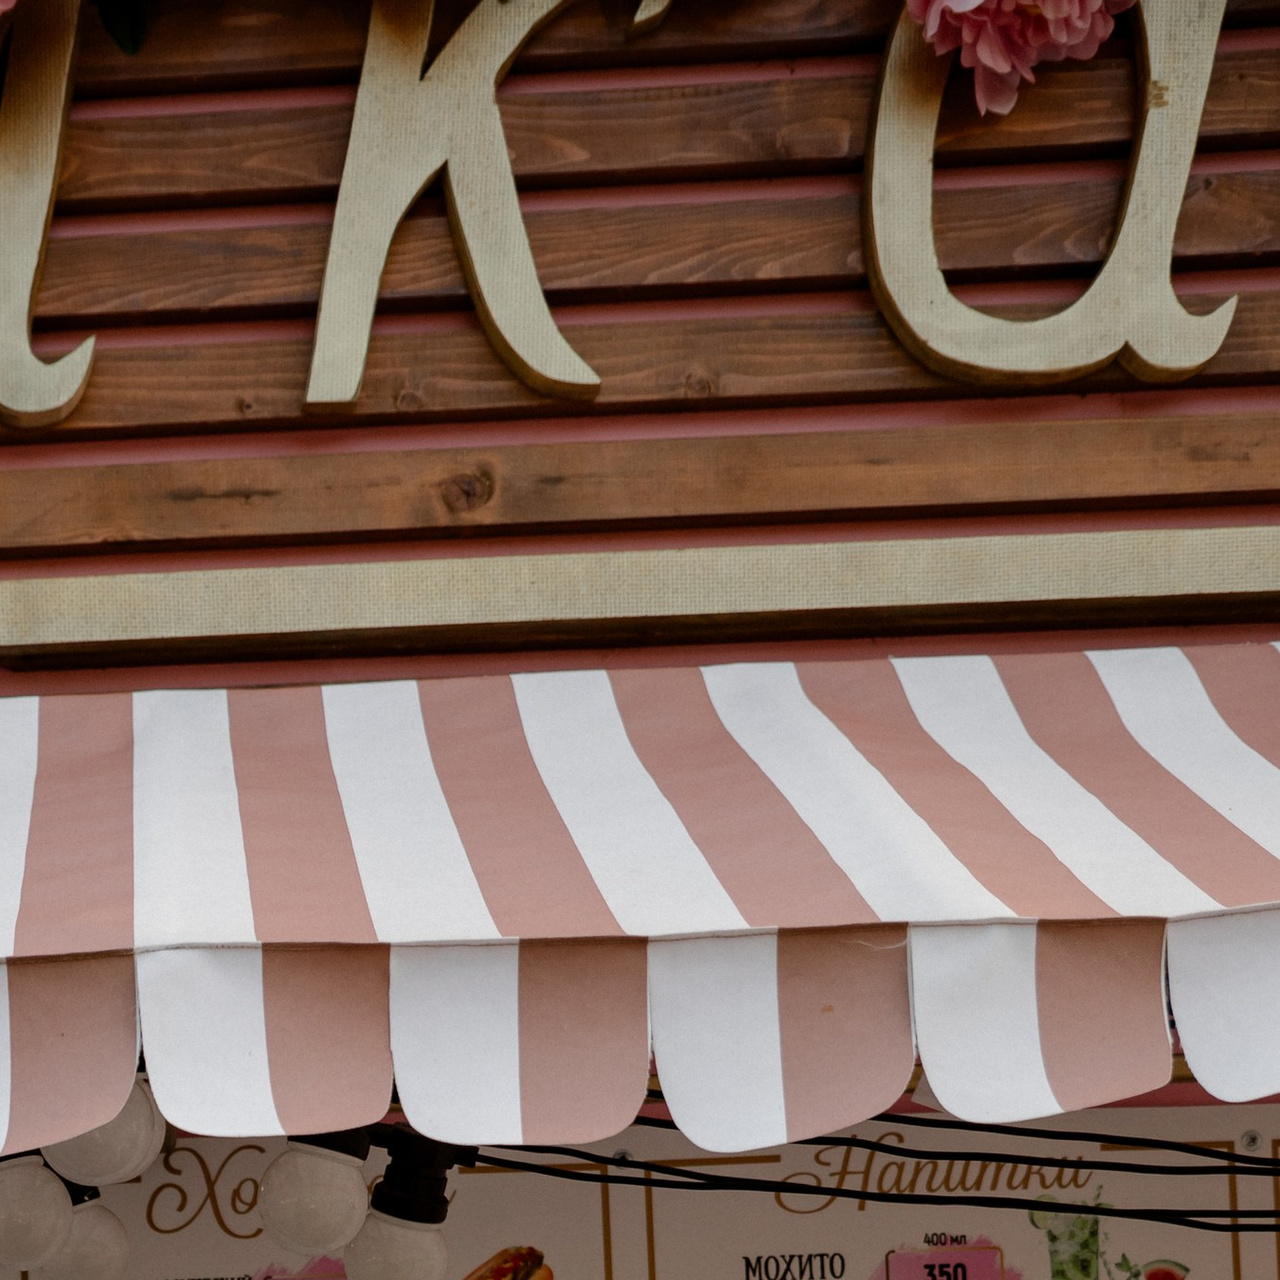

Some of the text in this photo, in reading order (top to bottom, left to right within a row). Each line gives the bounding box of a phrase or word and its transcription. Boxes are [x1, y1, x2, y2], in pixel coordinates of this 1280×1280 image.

[774, 1131, 1093, 1214] Напитки
[924, 1233, 966, 1246] 400 мл
